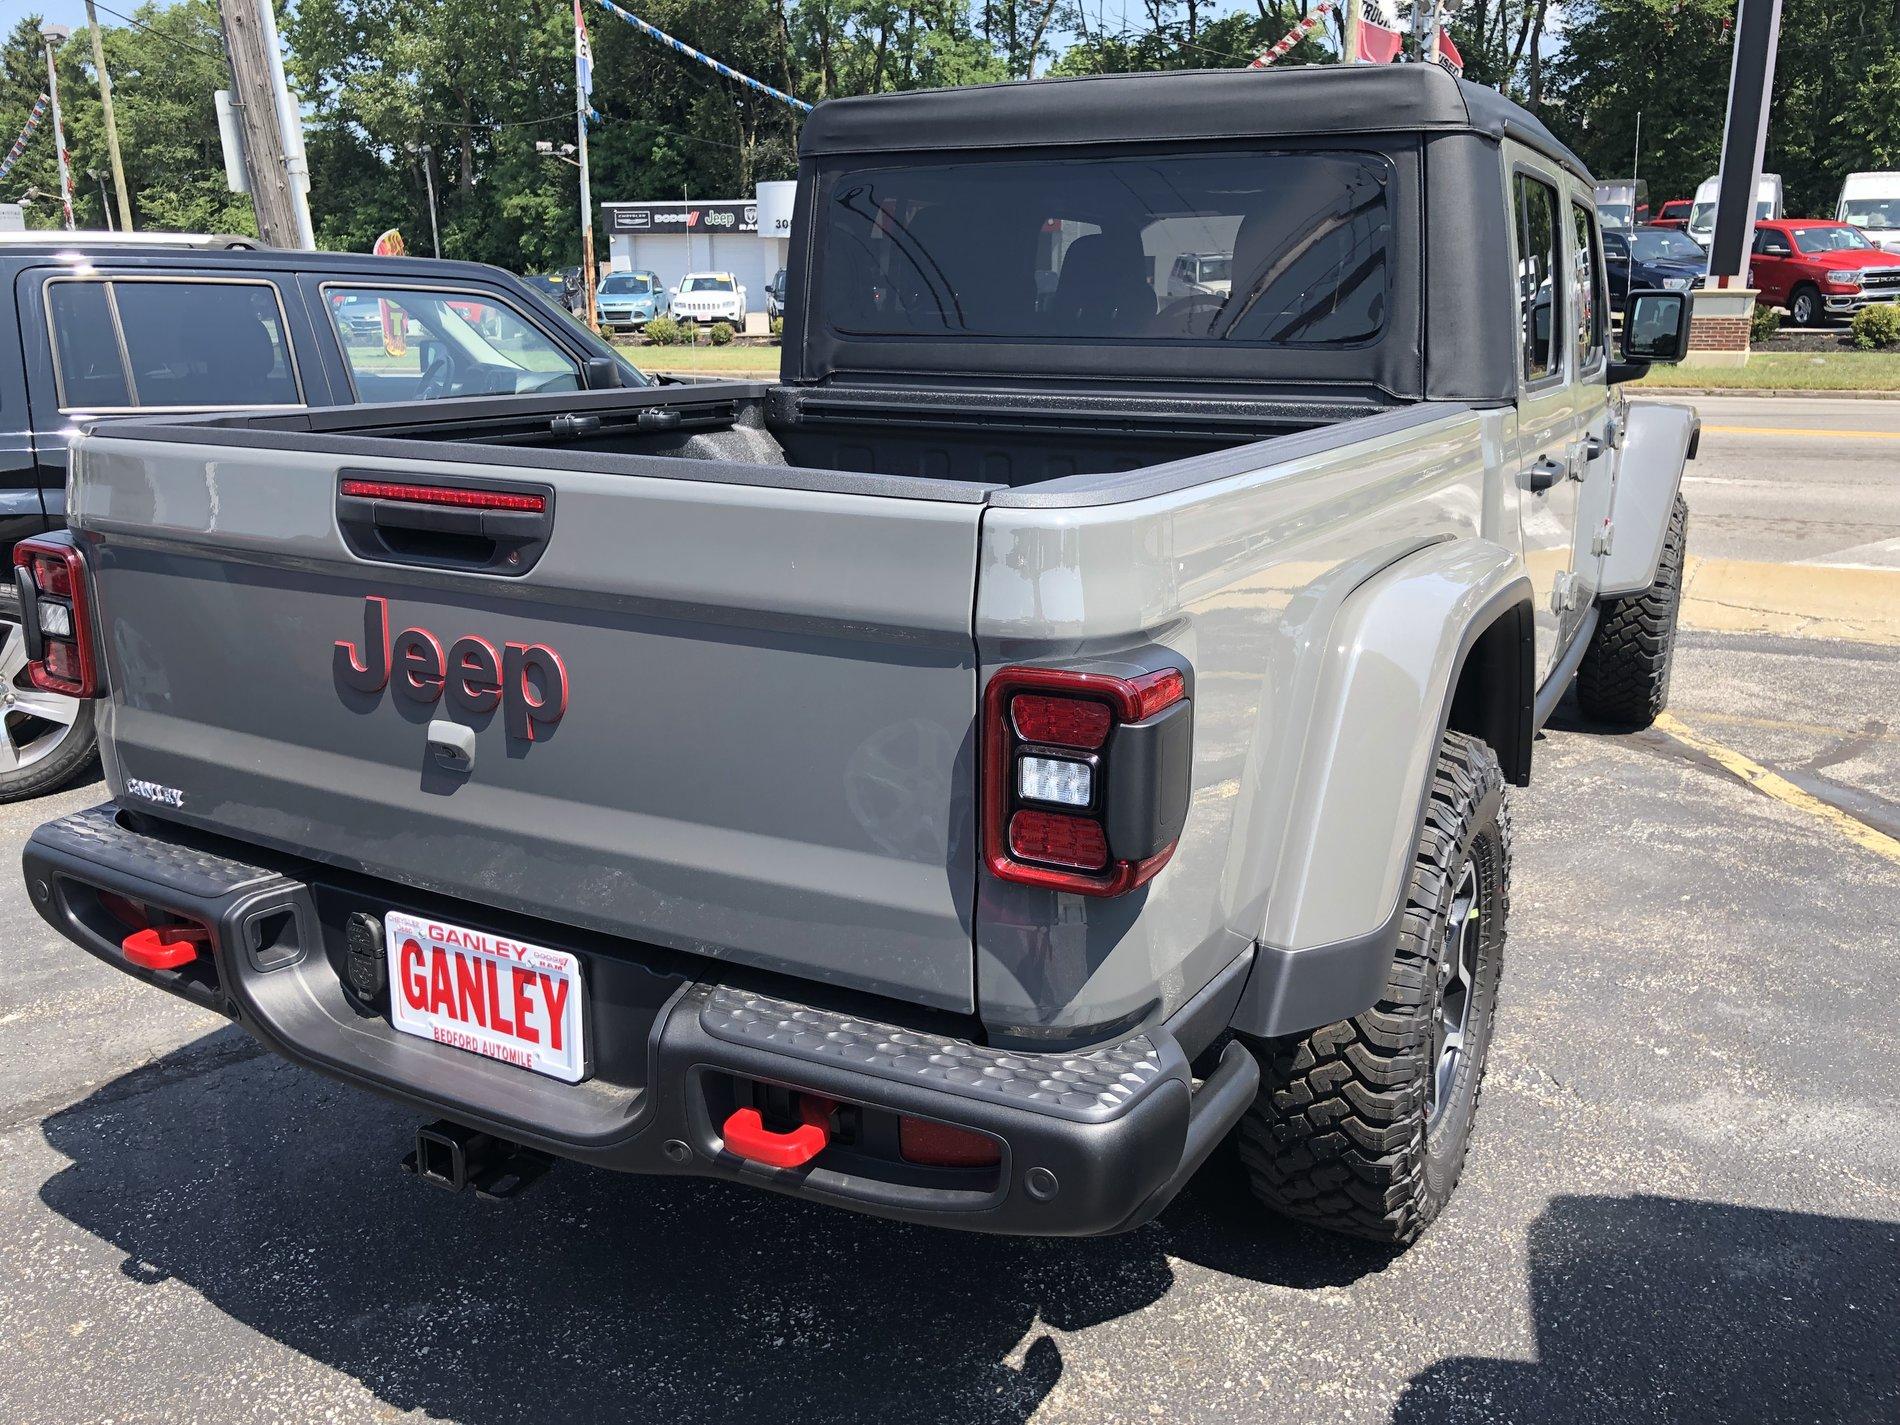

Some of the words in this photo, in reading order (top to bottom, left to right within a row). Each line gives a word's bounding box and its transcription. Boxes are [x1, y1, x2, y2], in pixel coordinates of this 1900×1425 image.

[654, 214, 689, 222] DODGE
[704, 209, 735, 228] Jeep
[738, 223, 758, 231] RA
[775, 219, 791, 229] 30
[333, 595, 569, 742] Jeep
[428, 924, 528, 961] GANLEY
[400, 938, 569, 1051] GANLEY
[434, 1027, 479, 1051] BEDFORD
[482, 1040, 532, 1068] AUTOMILE
